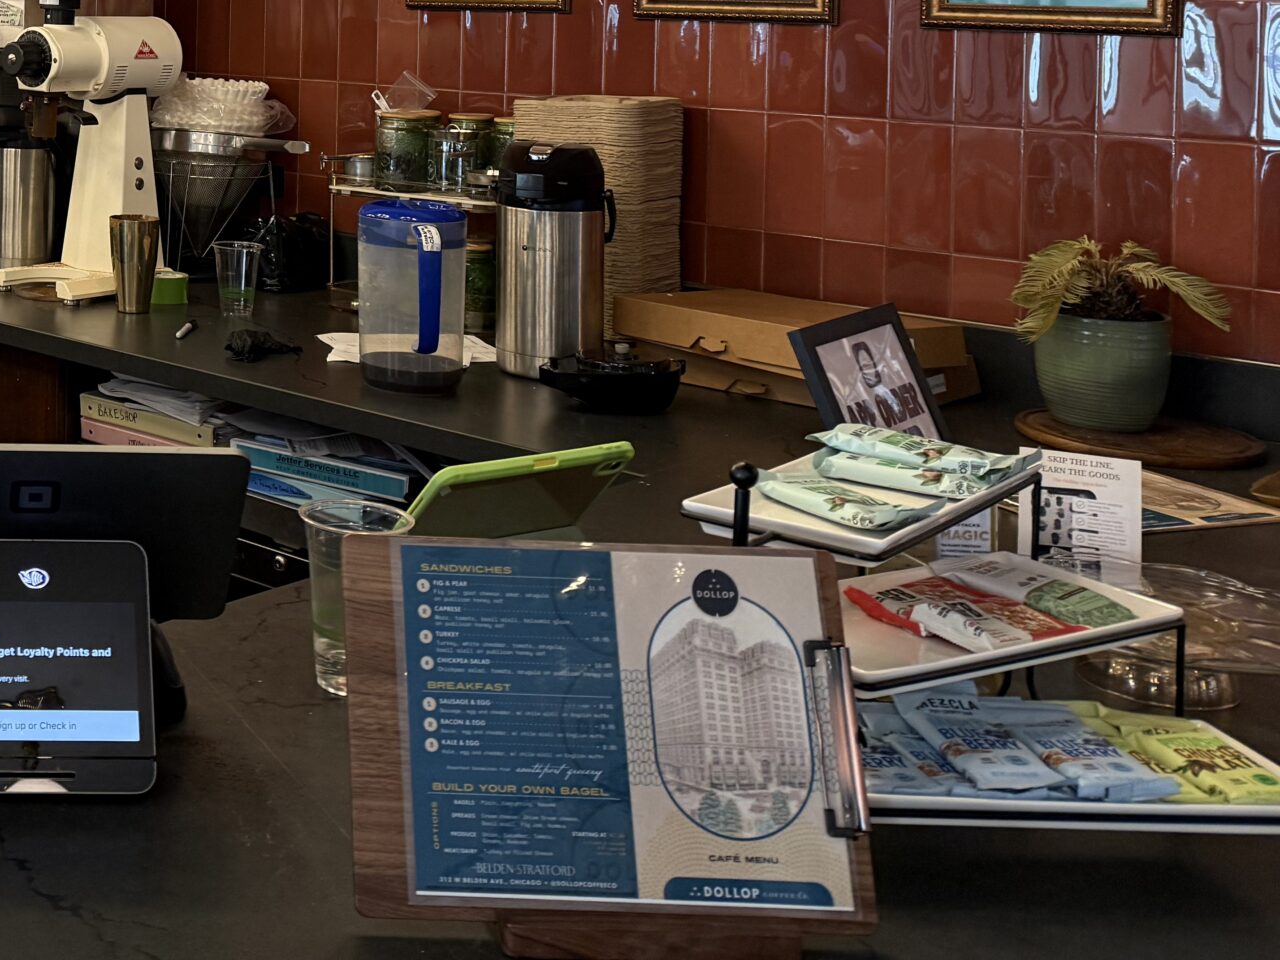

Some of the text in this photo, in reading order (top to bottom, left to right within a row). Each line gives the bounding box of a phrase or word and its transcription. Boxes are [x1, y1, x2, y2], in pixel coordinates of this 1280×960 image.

[1047, 455, 1068, 464] SKIP
[1069, 458, 1088, 467] THE
[1068, 468, 1087, 477] THE
[1088, 471, 1121, 481] GOODS
[941, 530, 990, 542] MAGIC
[420, 563, 513, 575] SANDWICHES
[696, 590, 736, 599] DOLLOP
[16, 646, 55, 658] Loyalty
[56, 647, 90, 657] Points
[91, 647, 112, 657] and
[13, 674, 30, 682] visit.
[427, 681, 512, 692] BREAKFAST
[916, 697, 980, 711] MEZCLA
[15, 723, 26, 731] up
[39, 721, 67, 730] Check
[68, 721, 77, 730] in
[938, 727, 985, 739] BLUE
[962, 737, 1023, 750] BERRY
[1036, 738, 1079, 751] BLUE
[1060, 748, 1122, 759] BERRY
[431, 782, 610, 797] BUILD YOUR OWN BAGEL
[708, 853, 779, 865] CAFÉ MENU
[703, 885, 760, 899] DOLLOP
